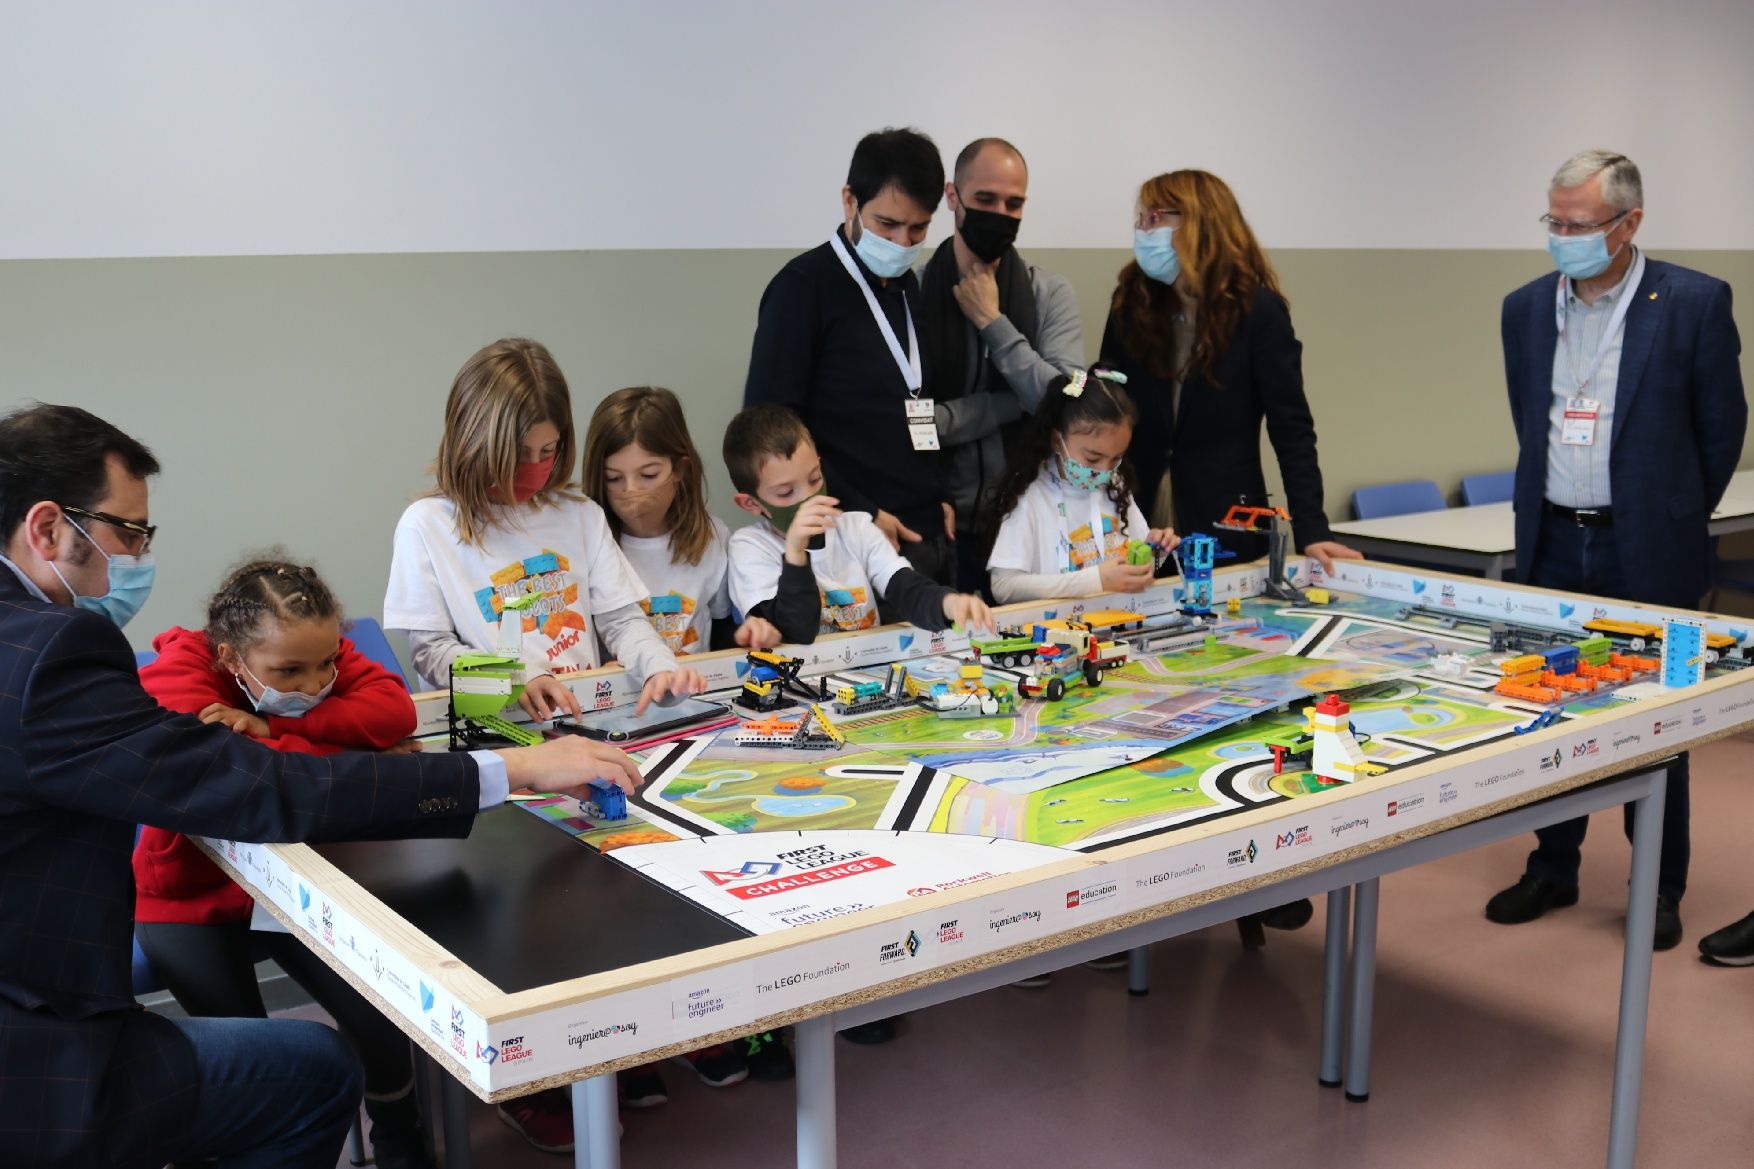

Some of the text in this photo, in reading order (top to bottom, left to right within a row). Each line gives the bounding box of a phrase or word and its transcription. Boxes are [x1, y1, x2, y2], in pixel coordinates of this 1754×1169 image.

[533, 573, 567, 593] BEST
[1484, 775, 1500, 786] LEGO
[1398, 797, 1424, 809] education
[1295, 825, 1309, 834] FIRST
[1295, 832, 1308, 840] LEGO
[1295, 835, 1312, 846] LEAGUE
[777, 844, 826, 860] FIRST
[786, 851, 835, 864] LEGO
[1228, 849, 1242, 857] FIRST
[796, 850, 870, 870] LEAGUE
[745, 860, 879, 895] CHALLENGE
[1136, 864, 1206, 888] The LEGO Foundation
[1080, 884, 1117, 900] education
[769, 904, 811, 917] amazon
[781, 905, 847, 924] future
[940, 920, 958, 930] FIRST
[940, 927, 957, 937] LEGO
[940, 932, 964, 943] LEAGUE
[880, 942, 899, 952] FIRST
[756, 962, 850, 995] The LEGO Foundation
[688, 1000, 715, 1011] future
[688, 1003, 724, 1019] engineer
[451, 1021, 466, 1040] FIRST
[501, 1036, 524, 1048] FIRST
[501, 1044, 523, 1056] LEGO
[501, 1049, 533, 1063] LEAGUE
